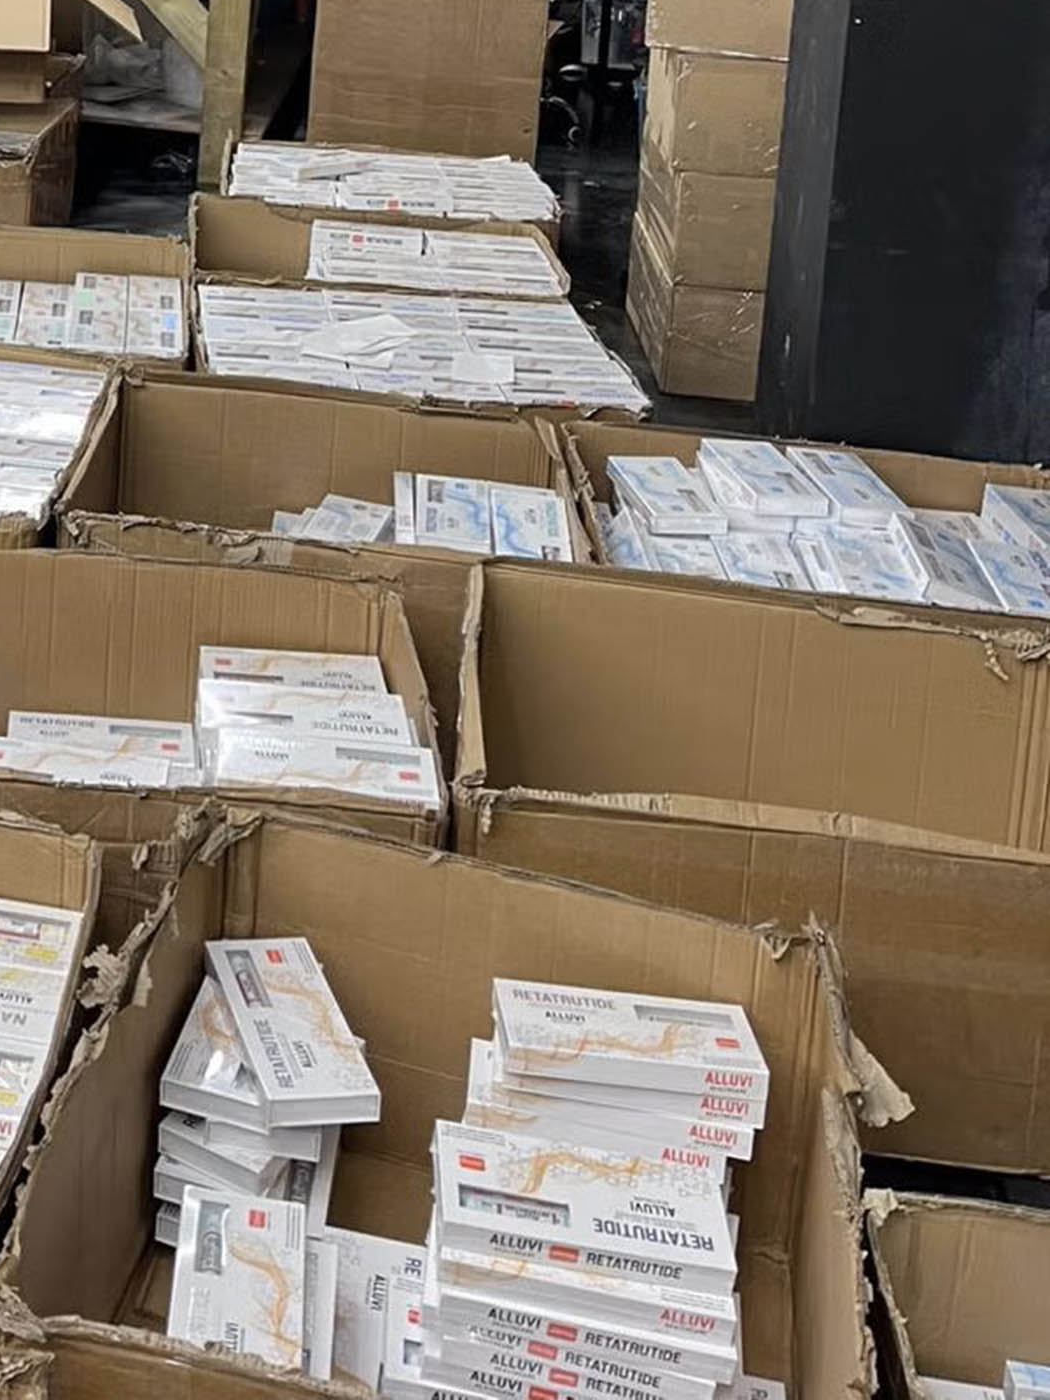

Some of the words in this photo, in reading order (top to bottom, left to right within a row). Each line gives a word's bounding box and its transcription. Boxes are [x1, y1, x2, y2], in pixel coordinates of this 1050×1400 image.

[511, 989, 618, 1011] RETATRUTIDE
[544, 1010, 587, 1023] ALLUVI
[253, 1017, 295, 1090] RETATRUTIDE
[704, 1070, 754, 1089] ALLUVI
[701, 1095, 750, 1117] ALLUVI
[688, 1123, 738, 1146] ALLUVI
[661, 1147, 711, 1169] ALLUVI
[629, 1200, 676, 1218] ALLUVI
[592, 1217, 714, 1251] RETATRUTIDE
[489, 1232, 544, 1253] ALLUVI
[586, 1251, 683, 1280] RETATRUTIDE
[370, 1273, 386, 1312] ALLUVI
[660, 1308, 716, 1331] ALLUVI
[488, 1307, 542, 1330] ALLUVI
[584, 1331, 683, 1364] RETATRUTIDE
[490, 1352, 543, 1375] ALLUVI
[564, 1351, 662, 1388] RETATRUTIDE
[470, 1370, 523, 1393] ALLUVI
